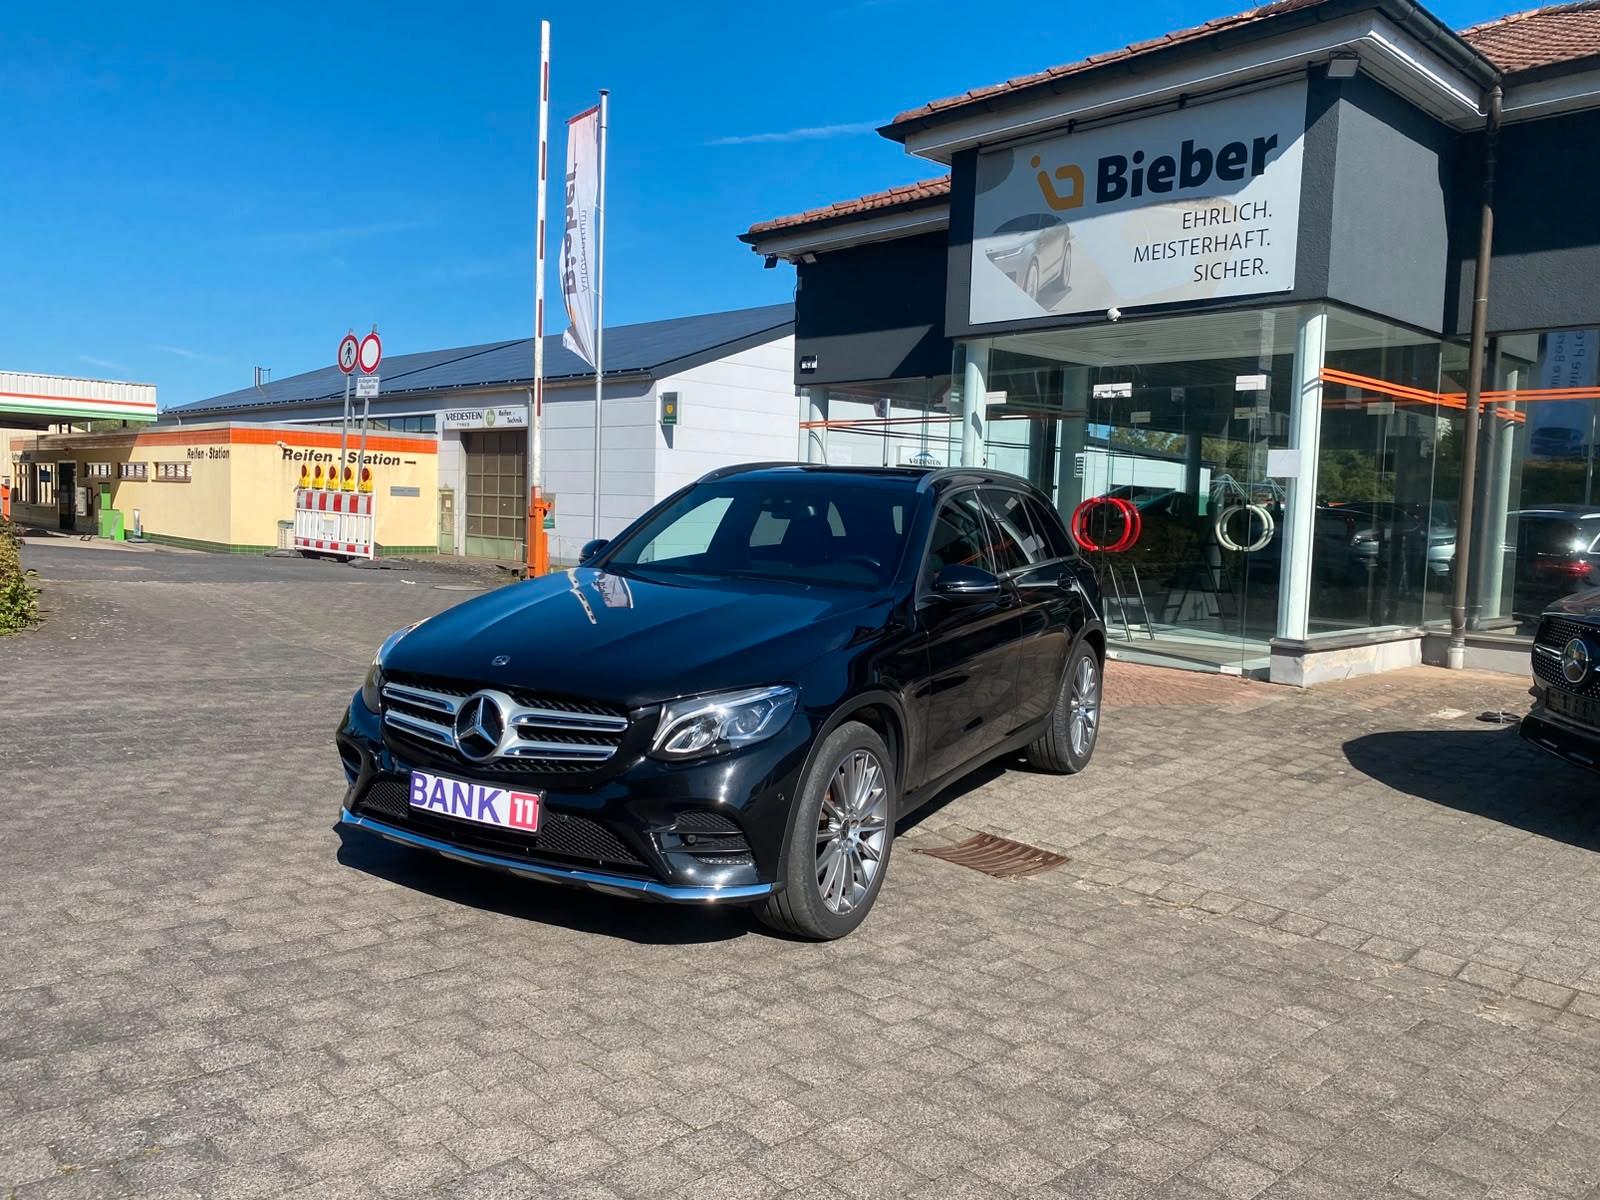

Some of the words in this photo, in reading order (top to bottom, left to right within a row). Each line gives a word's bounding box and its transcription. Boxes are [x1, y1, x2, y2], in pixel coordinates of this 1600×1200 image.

[1096, 134, 1278, 204] Bieber
[1182, 200, 1272, 229] EHRLICH.
[1133, 229, 1271, 263] MEISTERHAFT.
[1193, 258, 1269, 282] SICHER.
[445, 411, 483, 421] VREDESTEIN
[187, 447, 204, 459] Reifen
[209, 446, 230, 459] Station
[282, 448, 333, 462] Reifen
[409, 772, 503, 824] BANK
[514, 798, 534, 825] 11
